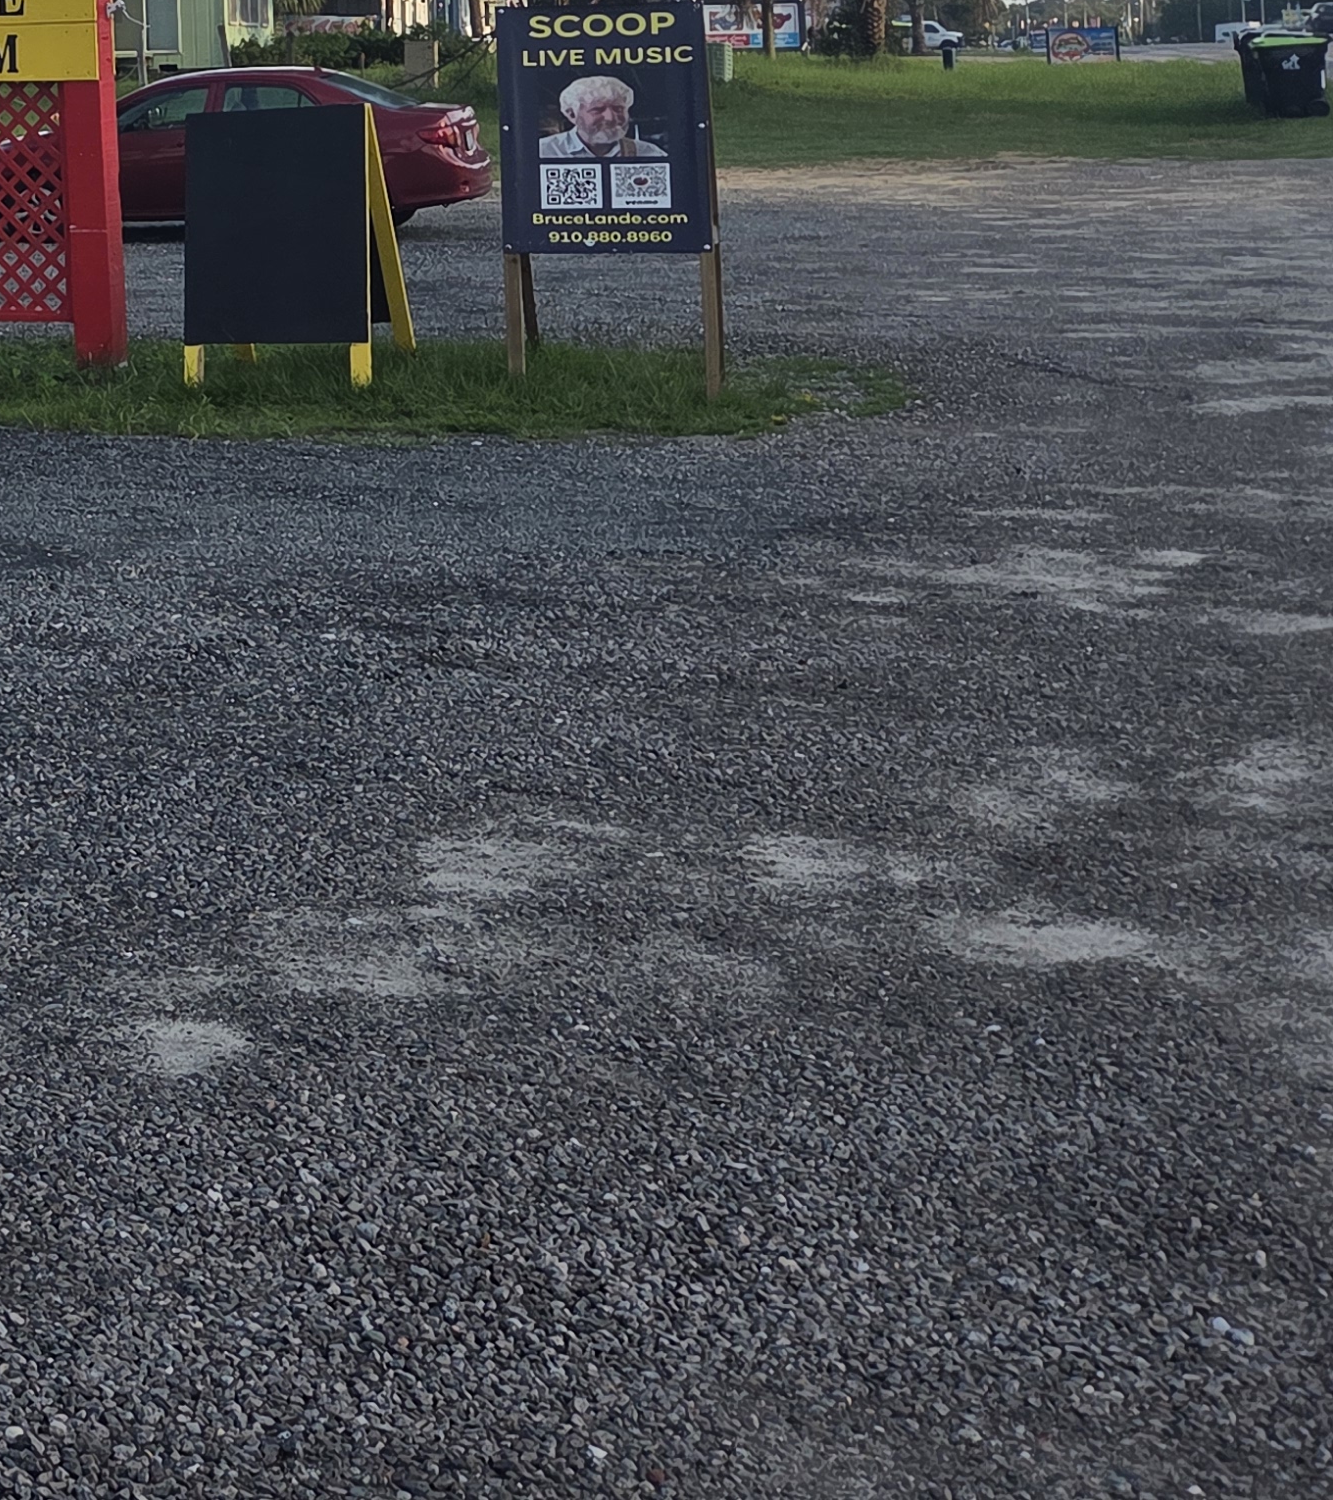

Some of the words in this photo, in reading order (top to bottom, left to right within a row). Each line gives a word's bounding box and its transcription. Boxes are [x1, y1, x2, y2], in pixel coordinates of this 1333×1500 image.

[528, 11, 675, 38] SCOOP
[522, 49, 586, 67] LIVE
[595, 45, 694, 65] MUSIC
[548, 230, 673, 244] 910.880.8960
